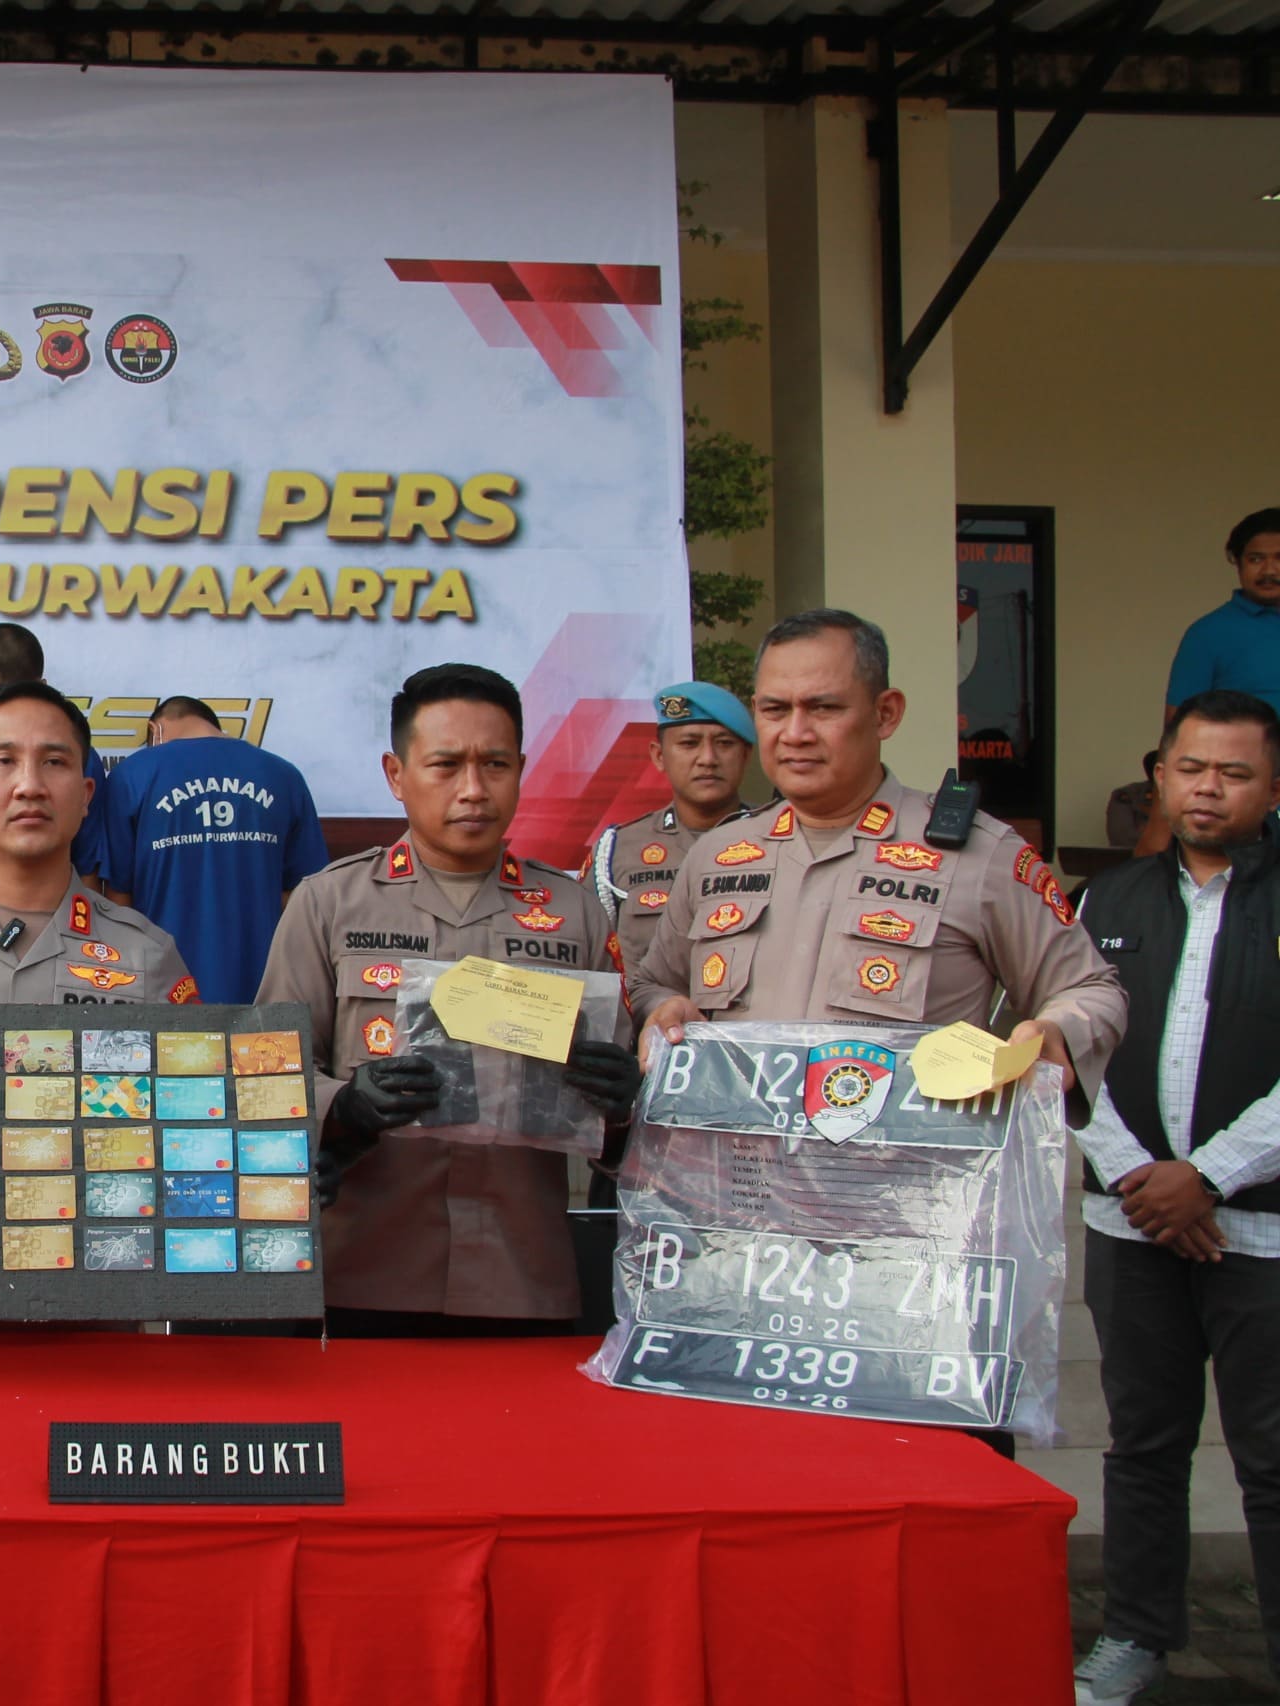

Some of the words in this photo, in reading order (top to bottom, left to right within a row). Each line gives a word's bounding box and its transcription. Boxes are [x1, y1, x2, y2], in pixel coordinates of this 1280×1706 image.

[258, 471, 520, 543] PERS
[958, 542, 988, 562] DIK
[992, 543, 1033, 565] JARI
[958, 740, 1013, 760] AKARTA
[156, 777, 275, 814] TAHANAN
[195, 800, 234, 827] 19
[152, 833, 203, 850] RESKRIM
[206, 831, 278, 844] PURWAKARTA
[628, 869, 680, 886] HERMA
[858, 875, 940, 905] POLRI
[345, 931, 429, 954] SOSIALISMAN
[504, 937, 578, 965] POLRI
[820, 1045, 888, 1064] INAFIS
[662, 1044, 697, 1096] B
[746, 1050, 806, 1104] 12
[651, 1231, 684, 1291] B
[740, 1241, 855, 1310] 1243
[896, 1259, 1005, 1328] ZMH
[631, 1330, 675, 1366] F
[732, 1338, 860, 1389] 1339
[924, 1355, 999, 1399] BV
[66, 1442, 209, 1476] BARANG
[223, 1441, 326, 1475] BUKTI
